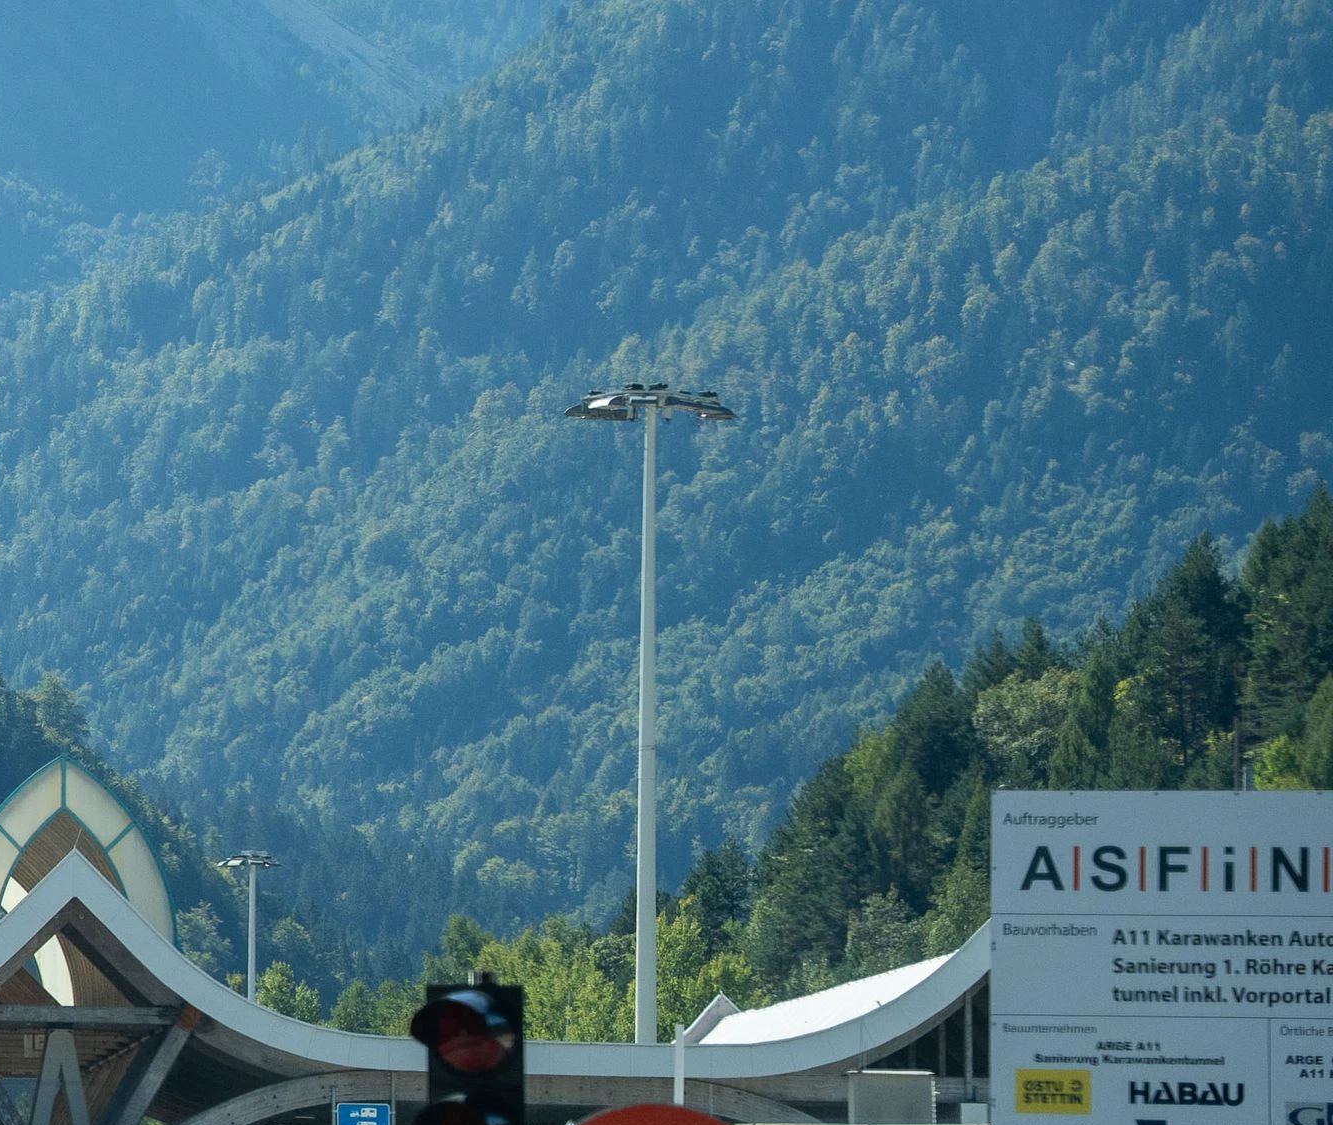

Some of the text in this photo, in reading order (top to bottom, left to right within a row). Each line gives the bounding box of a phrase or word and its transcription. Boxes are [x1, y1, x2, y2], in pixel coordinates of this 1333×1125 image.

[1002, 813, 1099, 828] Auftraggeber
[1002, 923, 1098, 937] Bauvorhaben
[1112, 929, 1151, 946] A11
[1156, 929, 1283, 947] Karawanken
[1112, 958, 1216, 979] Sanierung
[1223, 960, 1240, 975] 1.
[1246, 959, 1306, 976] Röhre
[1112, 986, 1332, 1008] tunnel inkl. Vorportal
[1002, 1023, 1098, 1034] Bauunternehmen
[1095, 1041, 1162, 1052] ARGE A11
[1033, 1053, 1226, 1067] Sanierung Karawankentunnel
[1285, 1055, 1324, 1065] ARGE
[1299, 1068, 1325, 1079] A11
[1023, 1093, 1084, 1105] STETTIN
[1128, 1081, 1245, 1107] HABAU
